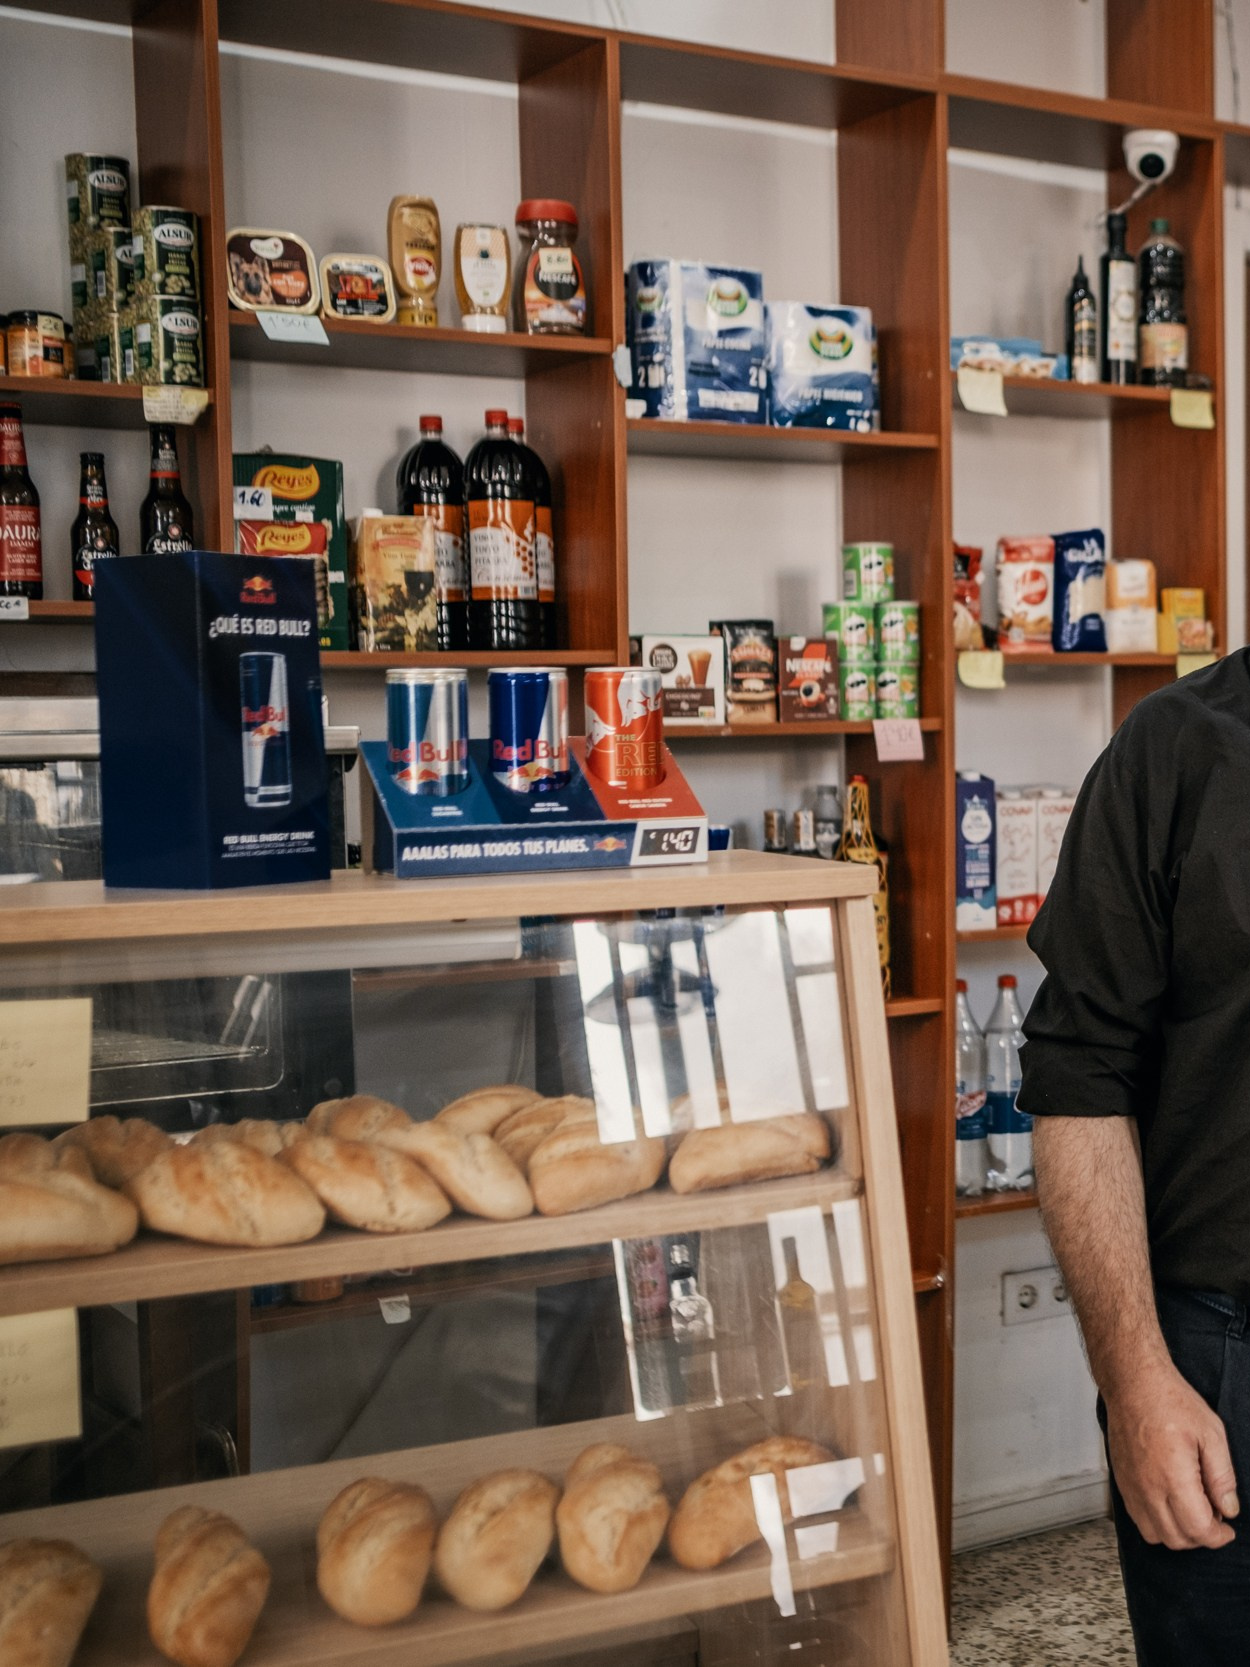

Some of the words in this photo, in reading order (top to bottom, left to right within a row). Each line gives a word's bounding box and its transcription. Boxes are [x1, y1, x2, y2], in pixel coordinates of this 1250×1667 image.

[158, 226, 194, 242] ALSUR
[260, 468, 315, 492] Reyes
[261, 526, 306, 548] Reyes
[208, 613, 240, 639] ¿QUÉ
[240, 617, 254, 635] ES
[255, 618, 278, 636] RED
[278, 619, 312, 637] BULL?
[244, 705, 268, 723] Red
[614, 733, 637, 742] THE
[419, 738, 468, 763] Bull
[493, 738, 532, 761] Red
[615, 741, 665, 767] RE
[615, 767, 658, 777] EDITION
[259, 832, 289, 843] ENERGY
[290, 830, 315, 841] DRINK
[450, 843, 482, 859] PARA
[483, 840, 521, 857] TODOS
[522, 839, 545, 855] TUS
[545, 838, 590, 854] PLANES.
